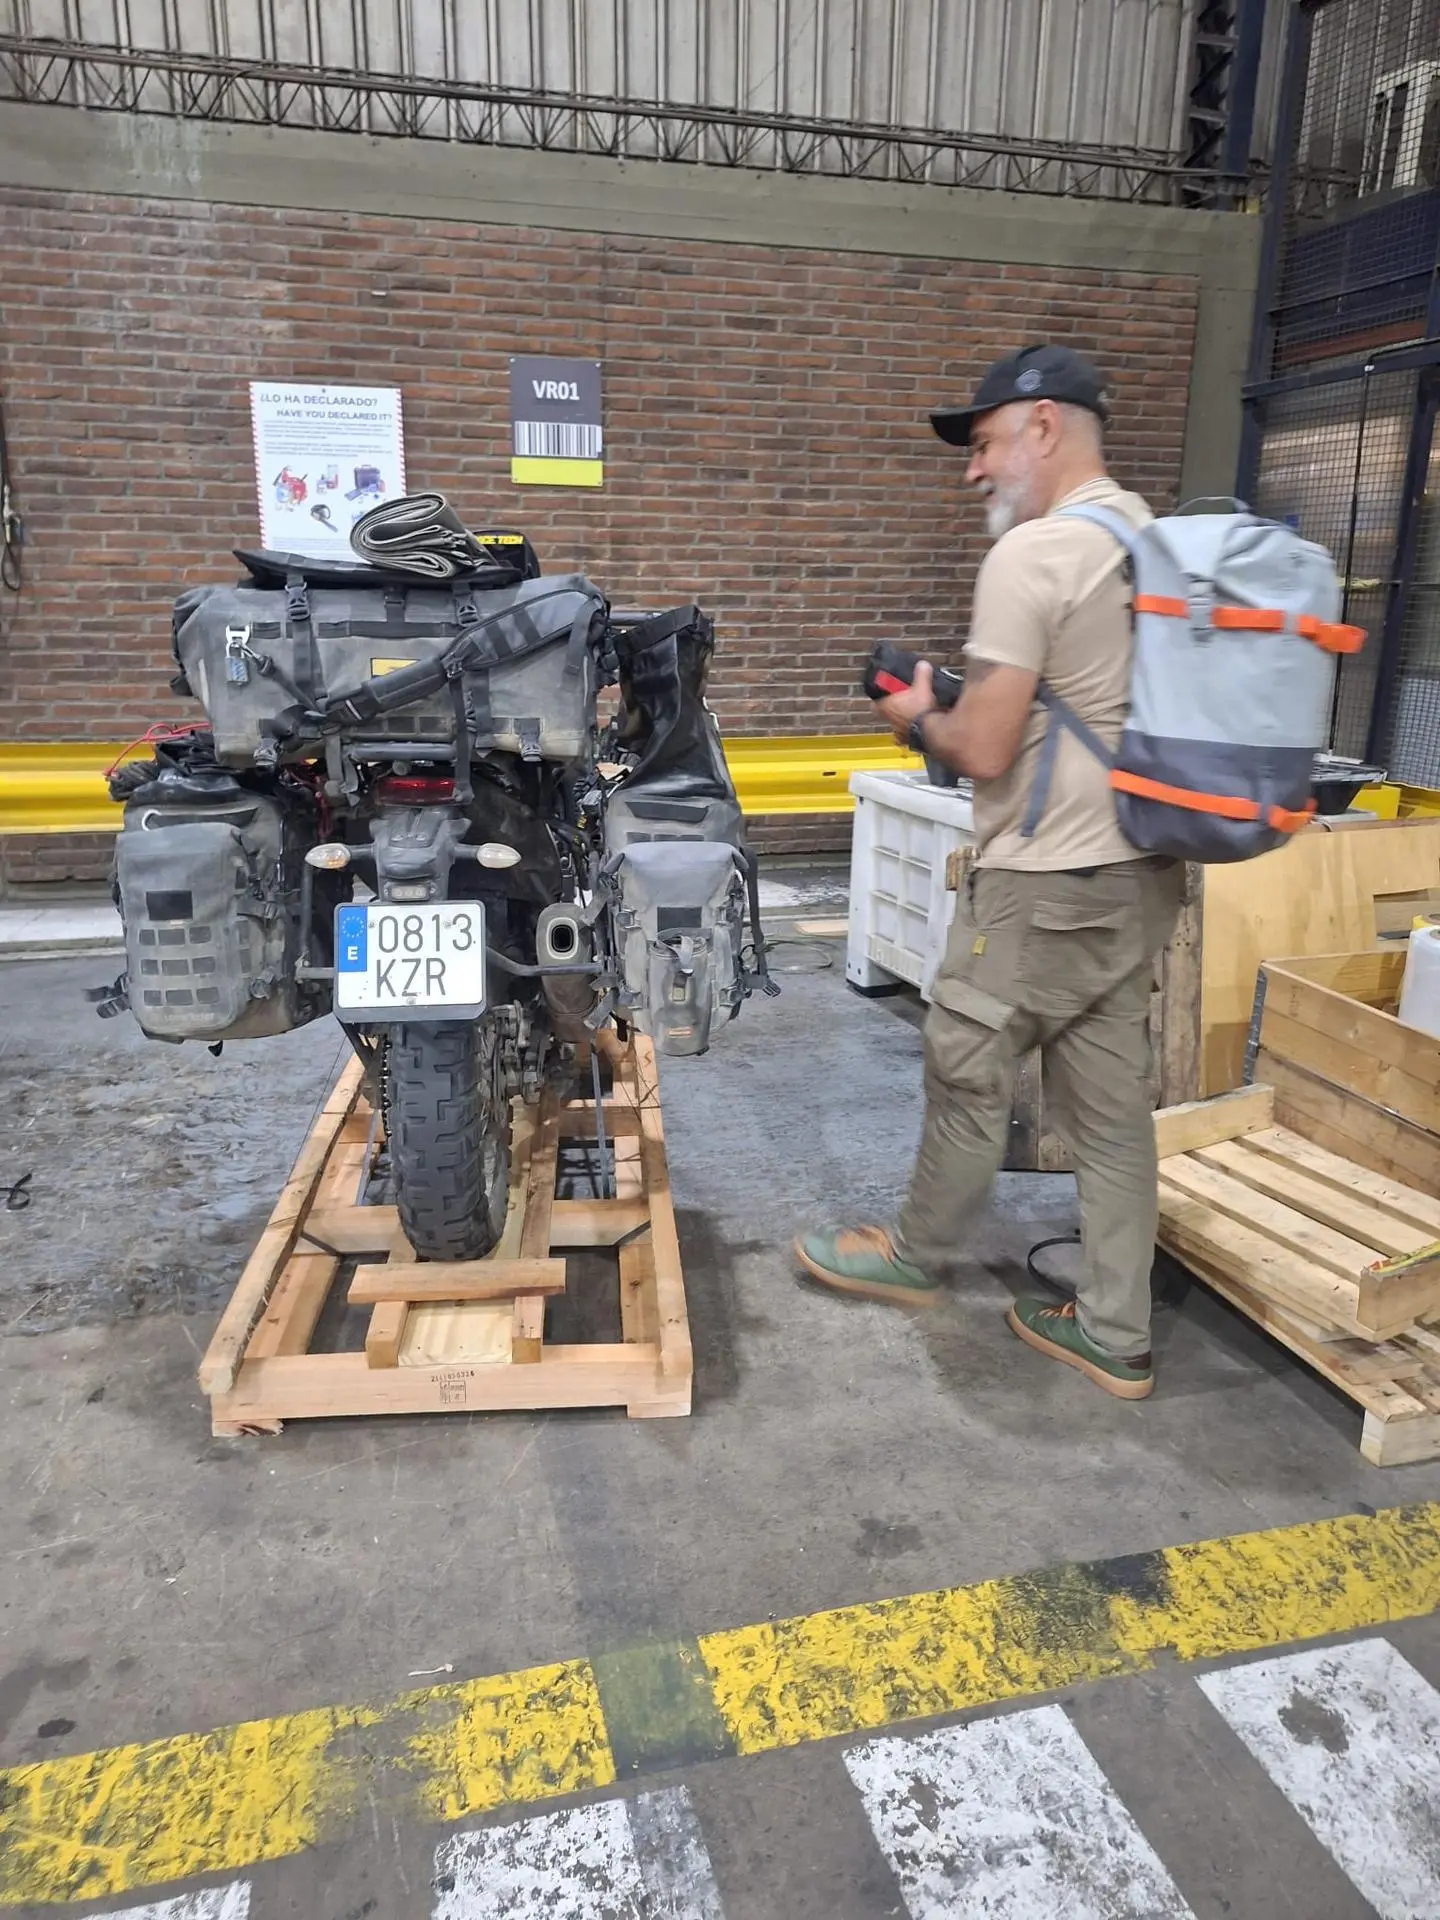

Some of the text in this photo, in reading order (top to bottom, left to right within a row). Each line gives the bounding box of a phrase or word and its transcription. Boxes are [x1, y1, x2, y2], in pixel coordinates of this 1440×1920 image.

[532, 380, 580, 401] VR01
[284, 395, 301, 404] HA
[304, 395, 378, 407] DECLARADO?
[277, 409, 392, 421] HAVE YOU DECLARED IT?
[378, 914, 472, 953] 0813
[347, 946, 358, 960] E
[376, 958, 446, 998] KZR
